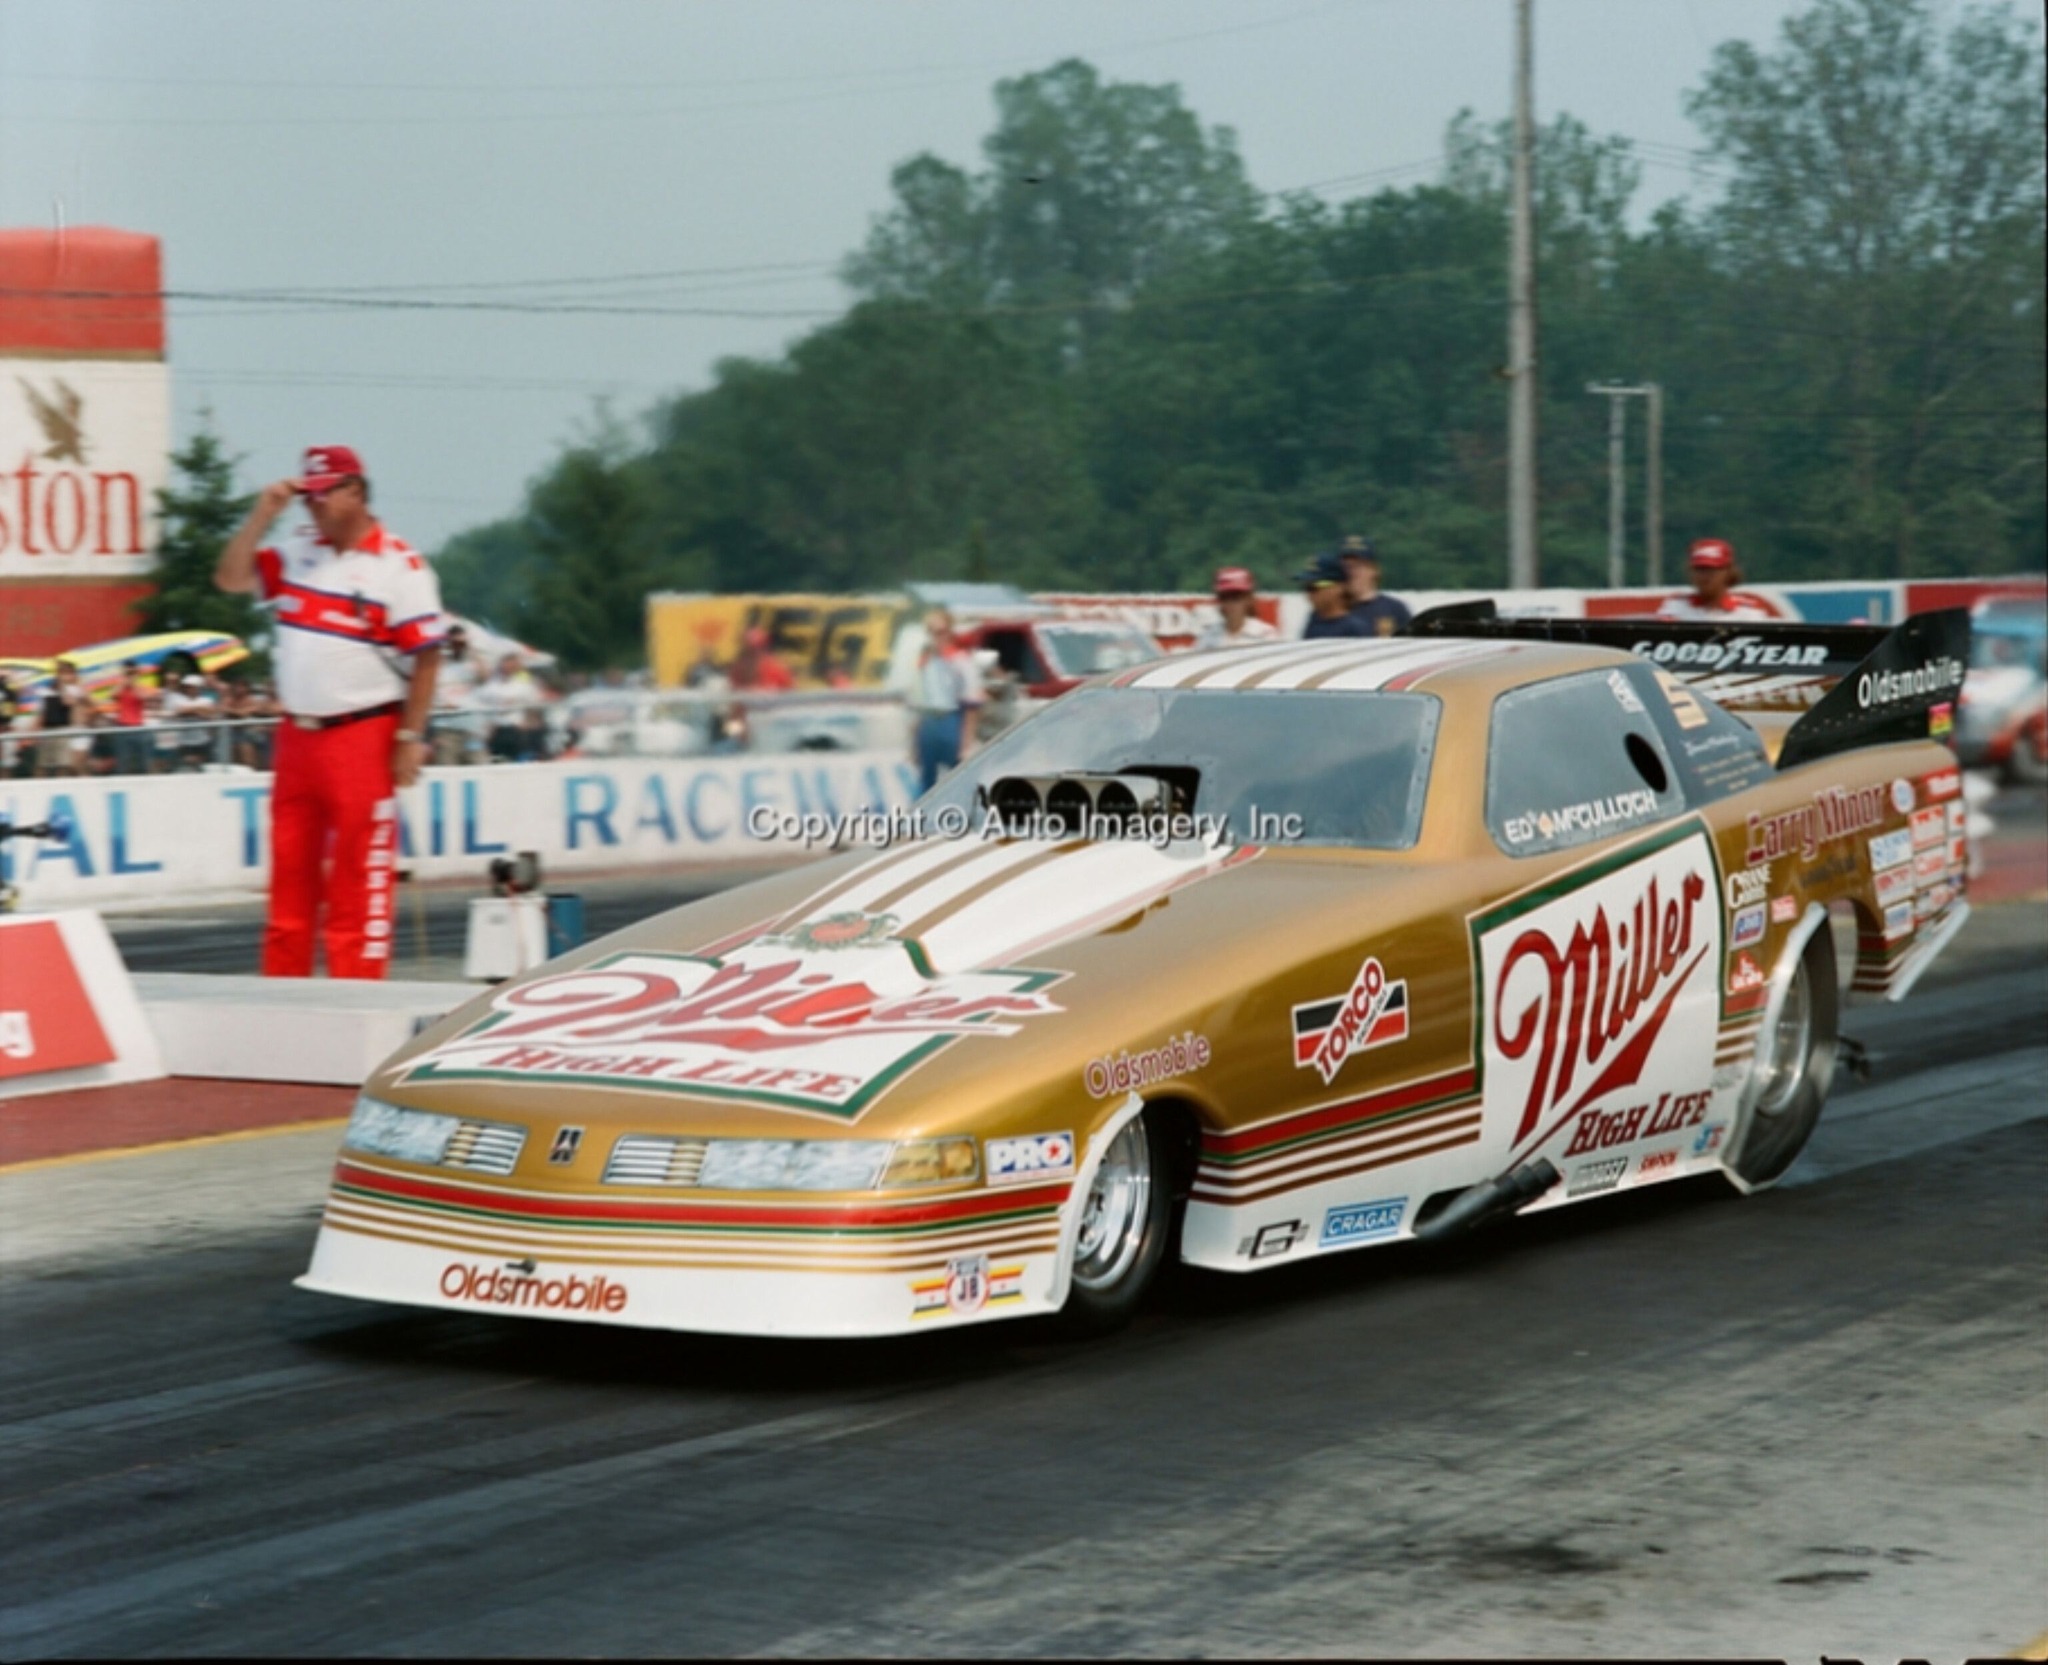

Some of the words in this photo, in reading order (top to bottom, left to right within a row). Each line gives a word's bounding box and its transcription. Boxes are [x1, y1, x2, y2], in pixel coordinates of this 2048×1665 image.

[1858, 655, 1963, 709] Oldsmobile
[1746, 805, 1820, 867] Larry
[1814, 784, 1886, 842] Minor
[1317, 960, 1382, 1077] TORCO
[1493, 869, 1706, 1153] Miller
[483, 1047, 658, 1076] HIGH
[686, 1061, 863, 1098] LIFE
[1085, 1032, 1211, 1098] Oldsmobile
[991, 1134, 1071, 1173] PRO
[1563, 1104, 1649, 1158] HIGH
[1640, 1090, 1713, 1139] LIFE
[1328, 1207, 1402, 1236] CRAGAR
[440, 1263, 628, 1312] Oldsmobile
